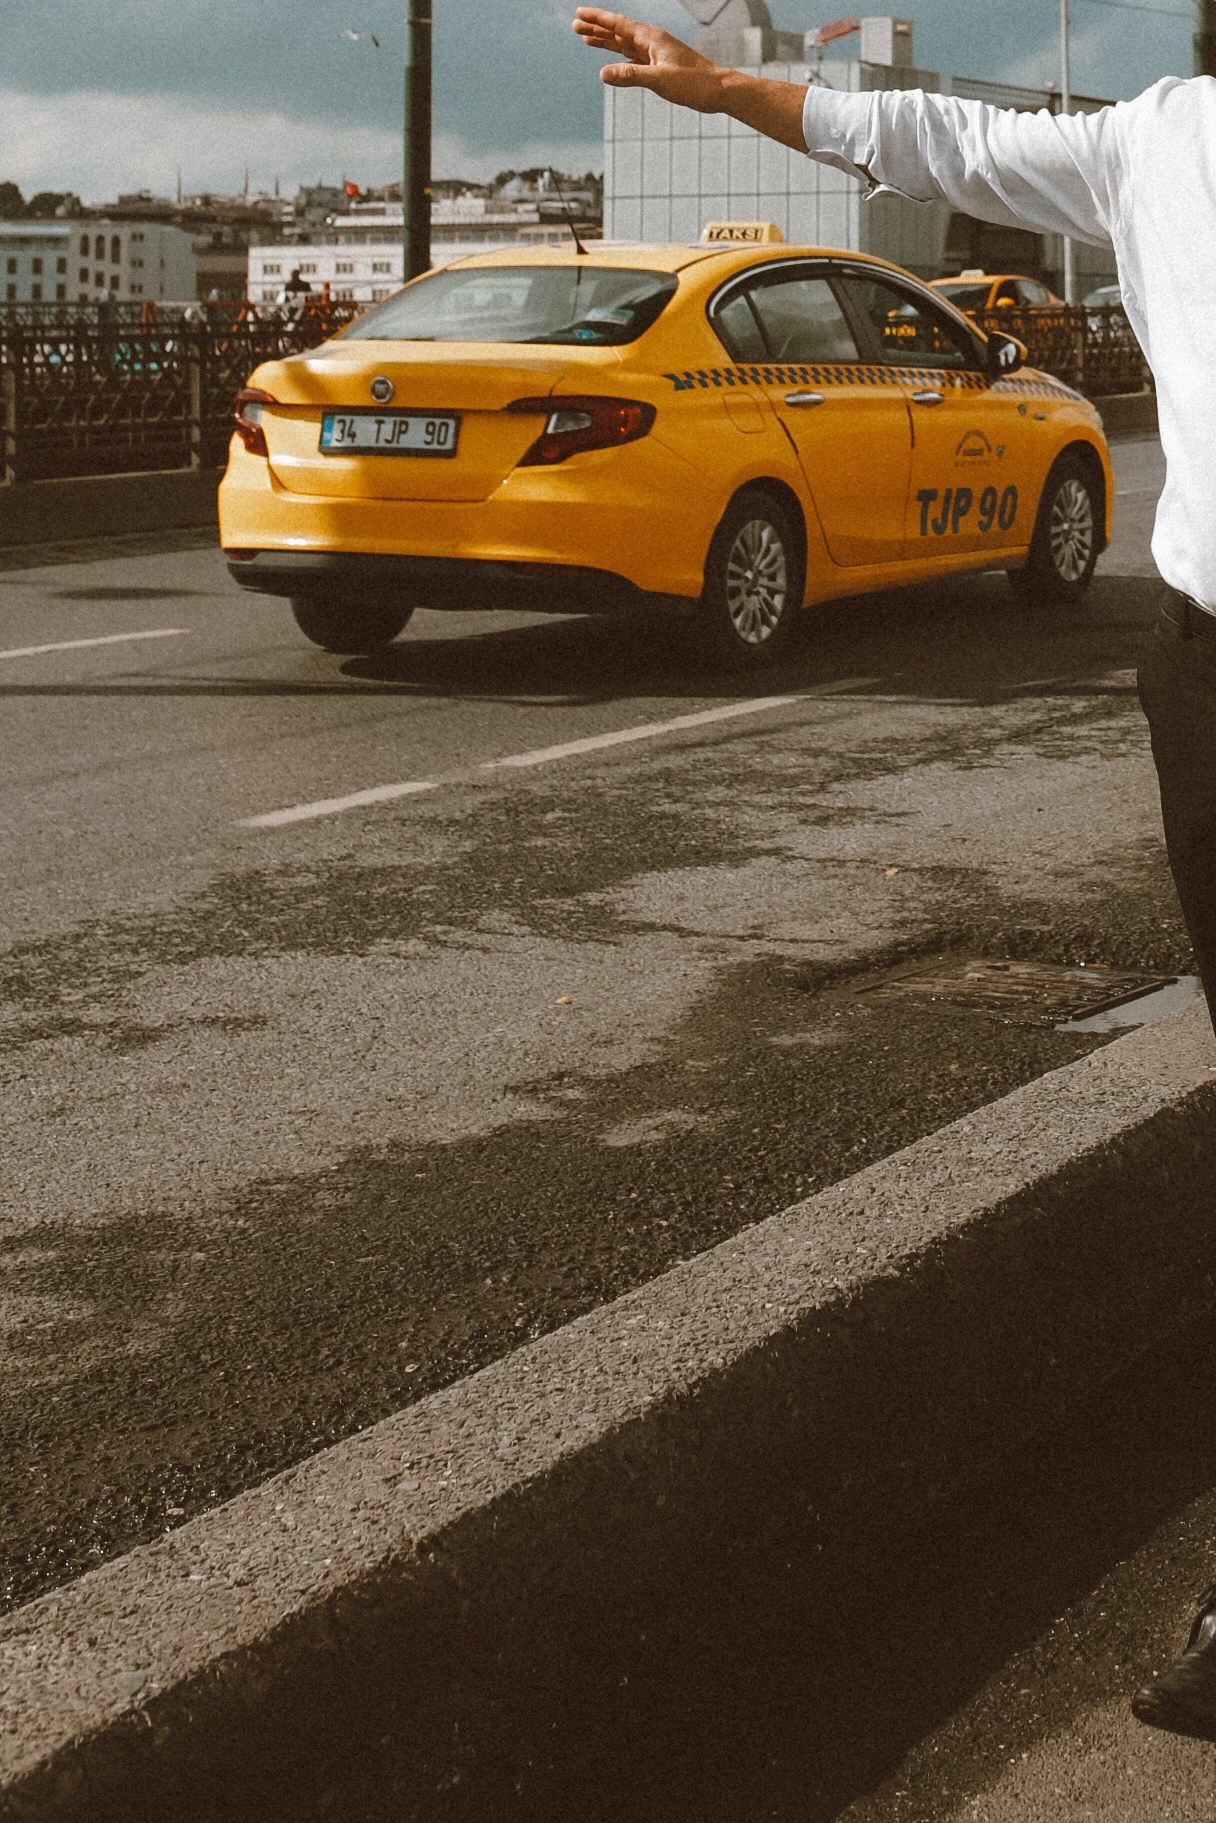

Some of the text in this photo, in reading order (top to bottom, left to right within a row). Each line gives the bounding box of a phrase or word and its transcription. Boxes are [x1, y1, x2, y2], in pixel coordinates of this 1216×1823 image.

[710, 227, 763, 241] TAKSI
[334, 418, 450, 447] 34 TJP 90
[916, 484, 1019, 537] TJP 90
